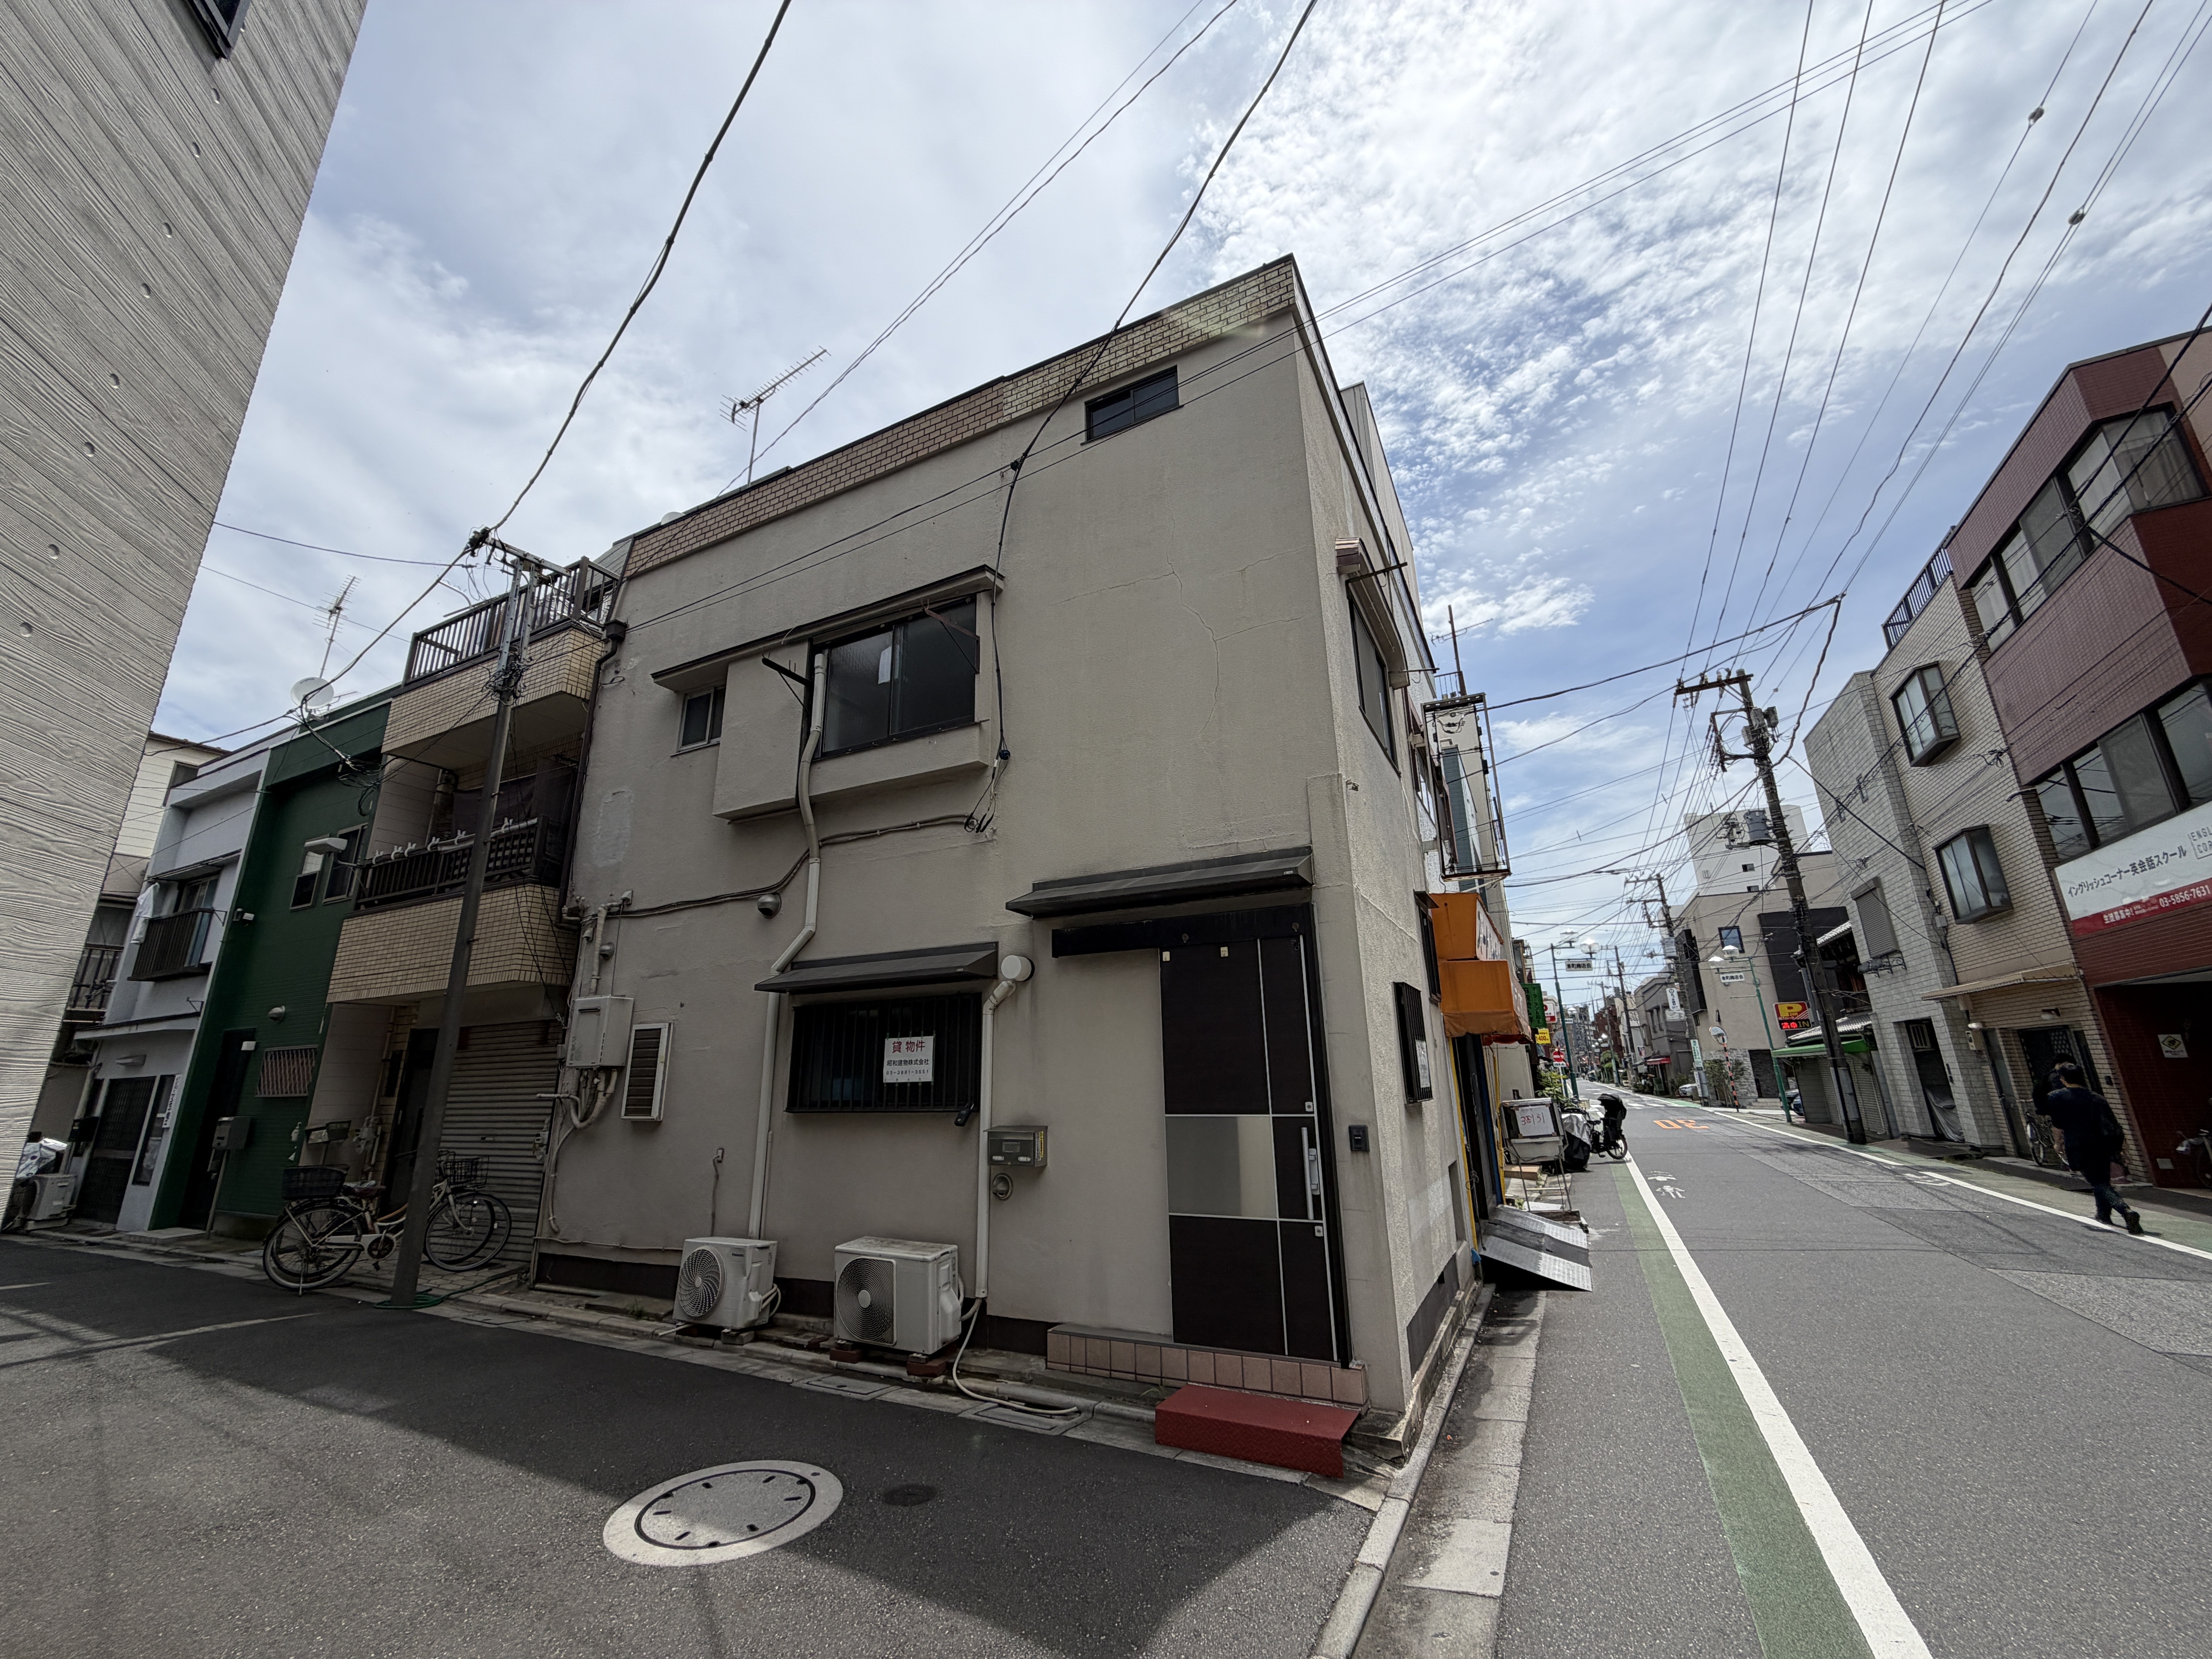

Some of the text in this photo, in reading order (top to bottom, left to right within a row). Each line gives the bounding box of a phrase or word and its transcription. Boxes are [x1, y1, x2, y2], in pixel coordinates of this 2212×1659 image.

[2068, 845, 2187, 898] イングリッシュコーナー英会話スクール
[2159, 884, 2210, 908] 03-5856-7631
[1778, 1003, 1802, 1017] P
